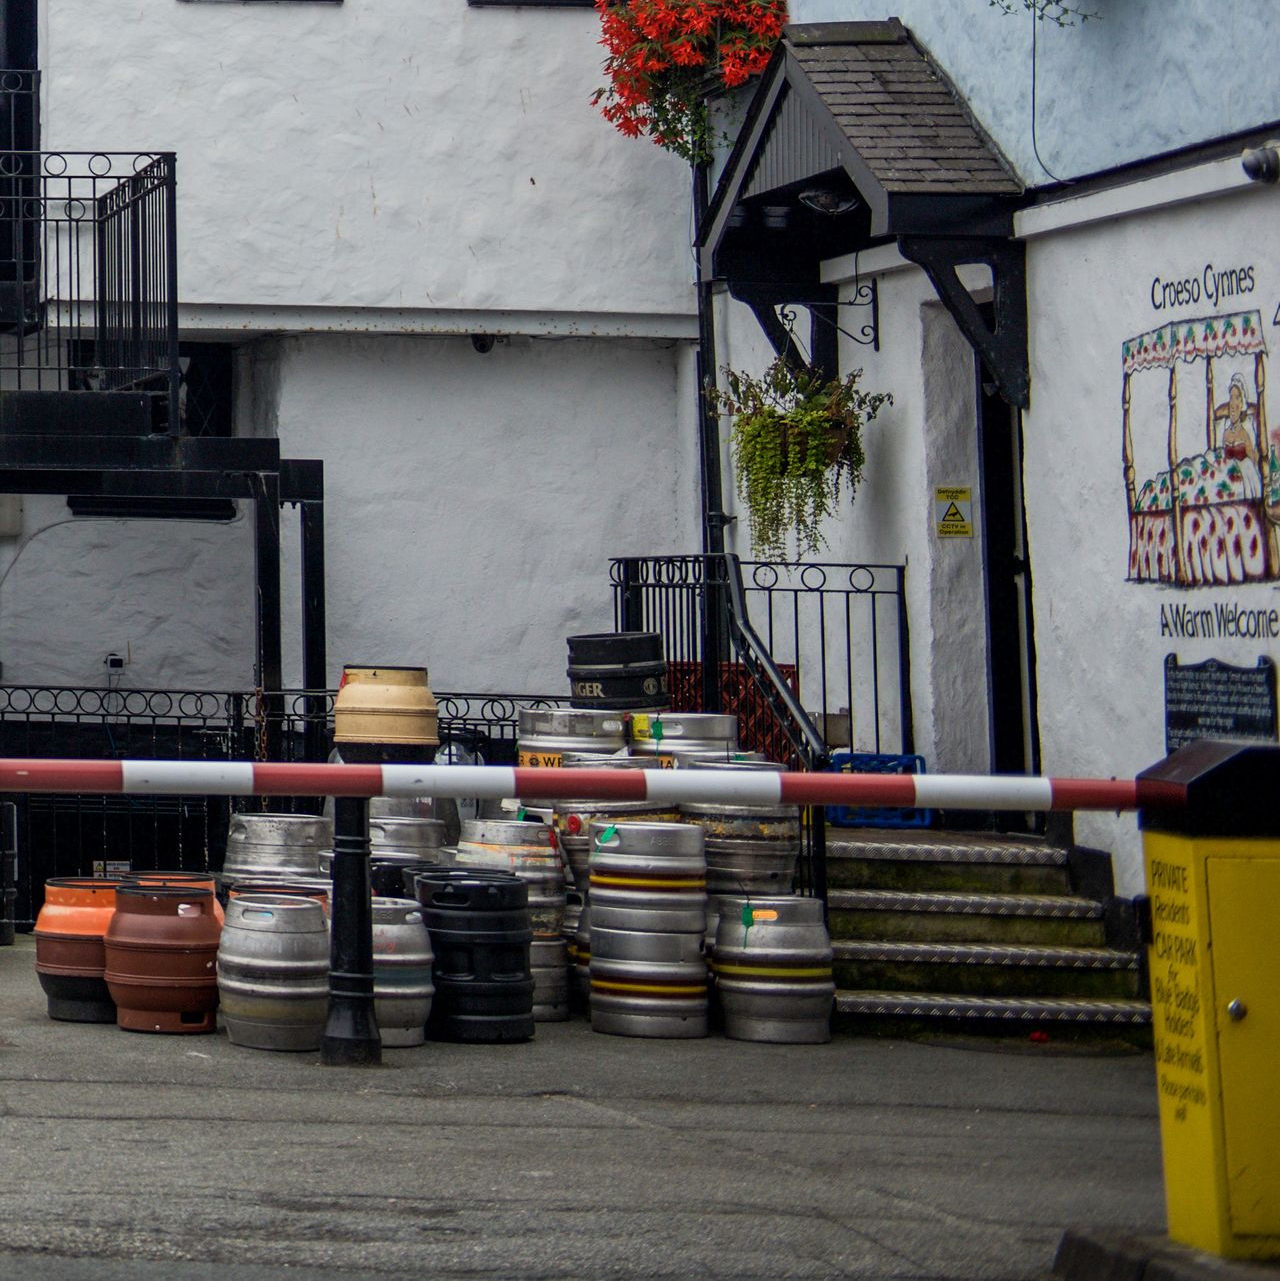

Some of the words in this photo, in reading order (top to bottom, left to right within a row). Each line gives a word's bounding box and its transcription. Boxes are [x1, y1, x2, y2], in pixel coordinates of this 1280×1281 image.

[1151, 277, 1201, 310] Croeso
[1203, 264, 1255, 307] Cynnes
[1160, 604, 1173, 637] A
[1169, 603, 1215, 638] Warm
[1214, 602, 1280, 638] Welcome
[1151, 859, 1189, 894] PRIVATE
